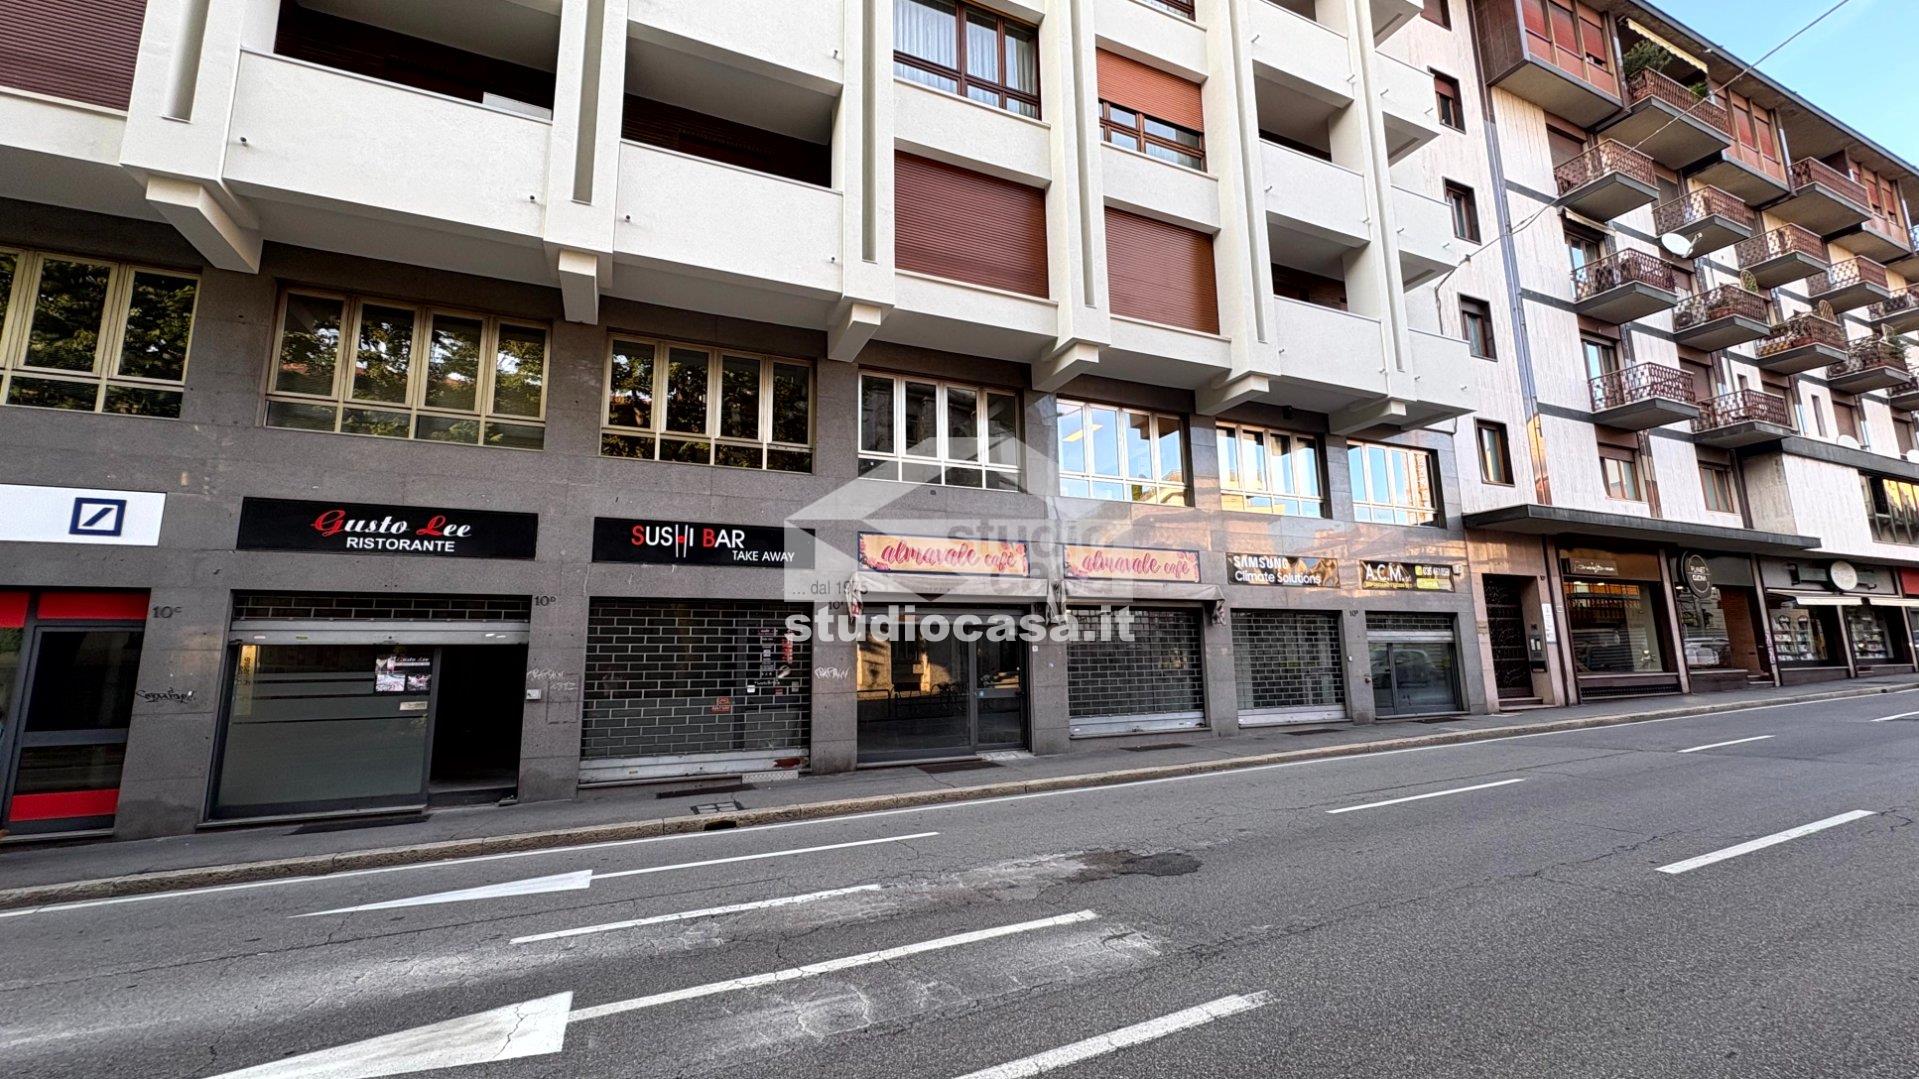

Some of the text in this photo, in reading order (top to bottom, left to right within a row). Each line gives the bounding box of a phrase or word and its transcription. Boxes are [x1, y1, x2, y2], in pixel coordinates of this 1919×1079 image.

[311, 509, 472, 537] Gusto Lee
[346, 537, 455, 552] RISTORANTE
[631, 524, 745, 559] SUSHI BAR
[732, 550, 795, 563] TAKE AWAY
[881, 541, 980, 567] almavale
[1082, 550, 1161, 574] almavale
[1233, 555, 1290, 569] SAMSUNG
[1235, 570, 1322, 584] Climate Solutions
